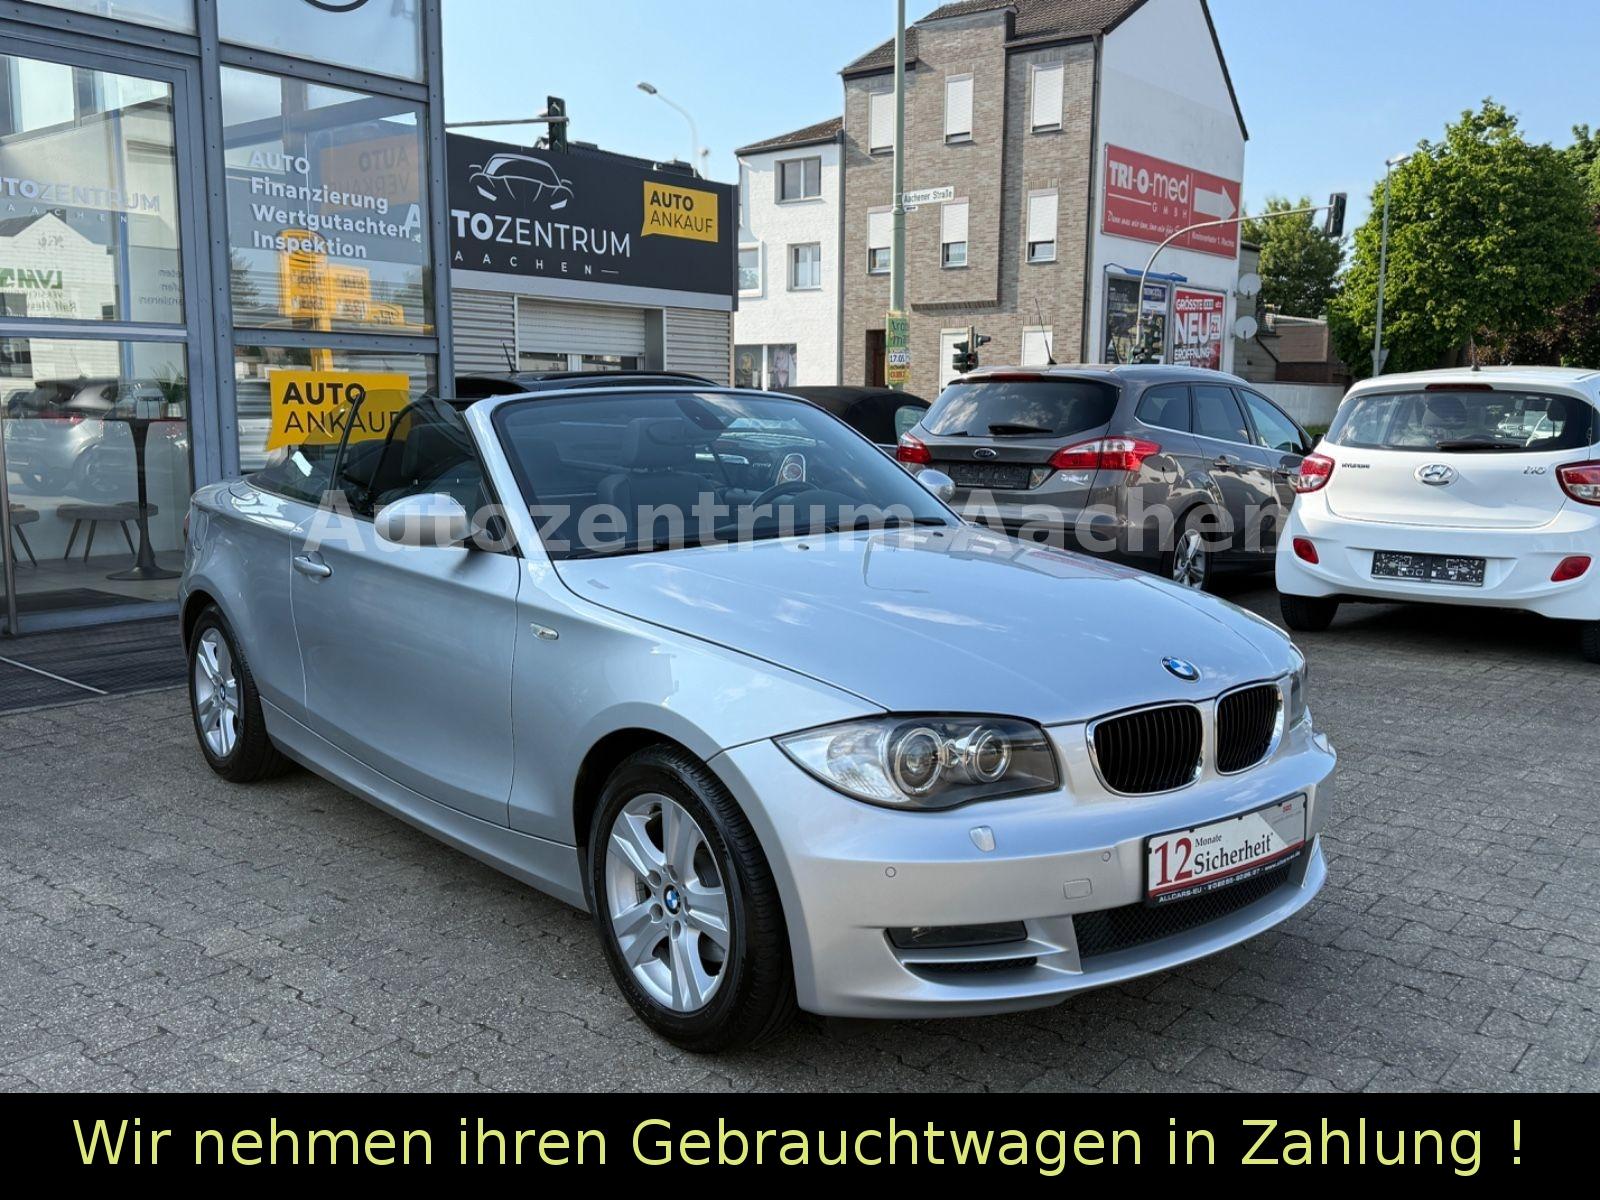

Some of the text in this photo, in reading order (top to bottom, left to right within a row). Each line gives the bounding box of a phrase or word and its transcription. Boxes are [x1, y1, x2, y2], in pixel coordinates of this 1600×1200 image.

[250, 151, 311, 174] AUTO
[0, 176, 160, 212] TOZENTRUM
[251, 176, 388, 214] Finanzierung
[650, 190, 694, 212] AUTO
[8, 203, 128, 224] AACHEN
[252, 203, 410, 239] Wertgutachten
[650, 209, 713, 233] ANKAUF
[253, 230, 367, 258] Inspektion
[454, 250, 592, 275] AACHEN
[1174, 312, 1210, 345] NEU
[282, 382, 366, 406] AUTO
[1195, 834, 1222, 848] Monate
[1155, 837, 1193, 886] 12
[1194, 835, 1271, 875] Sicherheit
